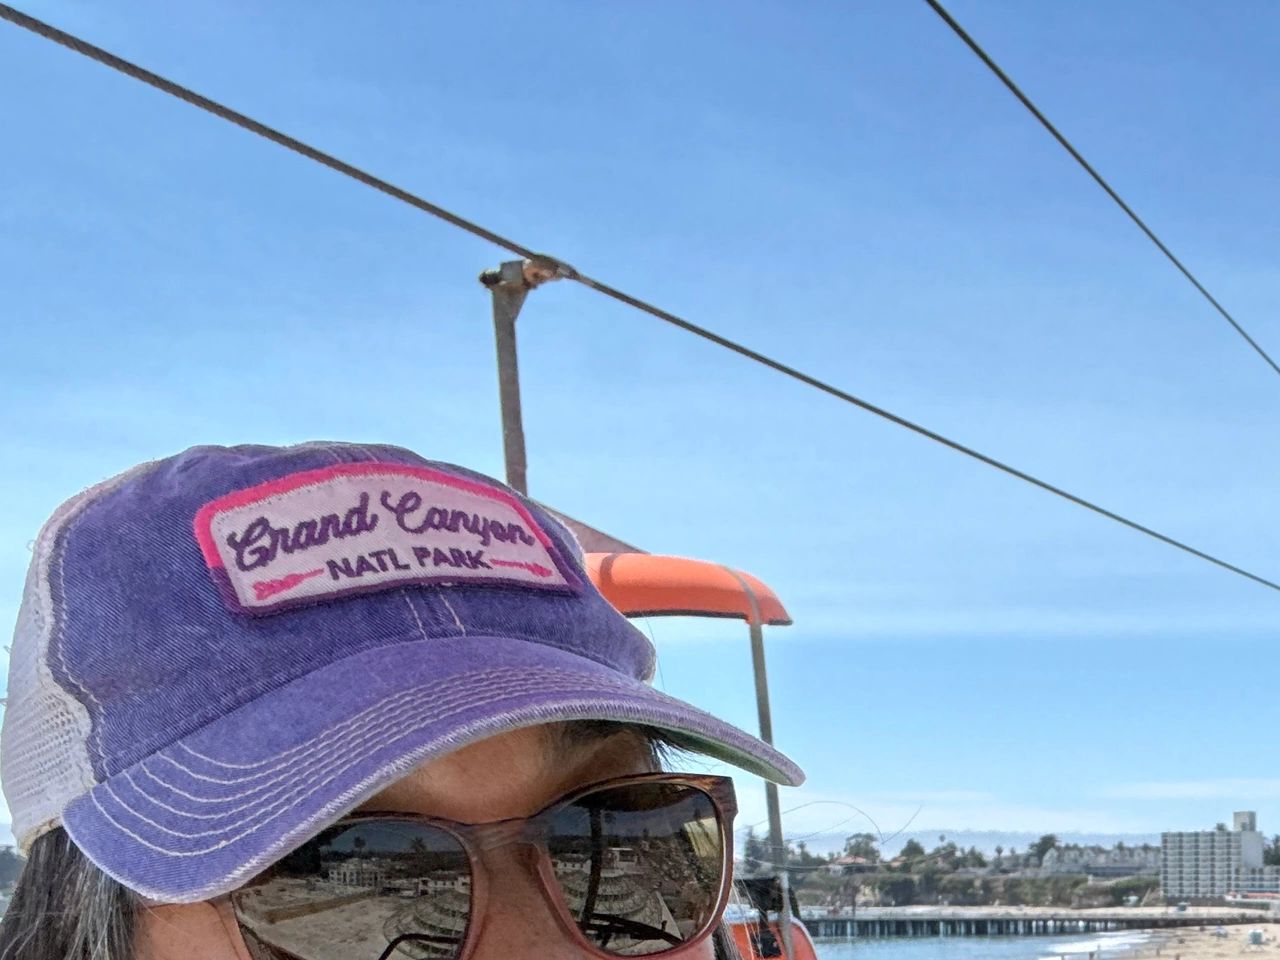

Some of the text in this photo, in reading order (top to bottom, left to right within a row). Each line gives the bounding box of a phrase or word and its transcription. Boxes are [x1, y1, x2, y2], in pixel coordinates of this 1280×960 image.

[226, 490, 536, 572] Grand Canyon
[412, 546, 493, 570] PARK
